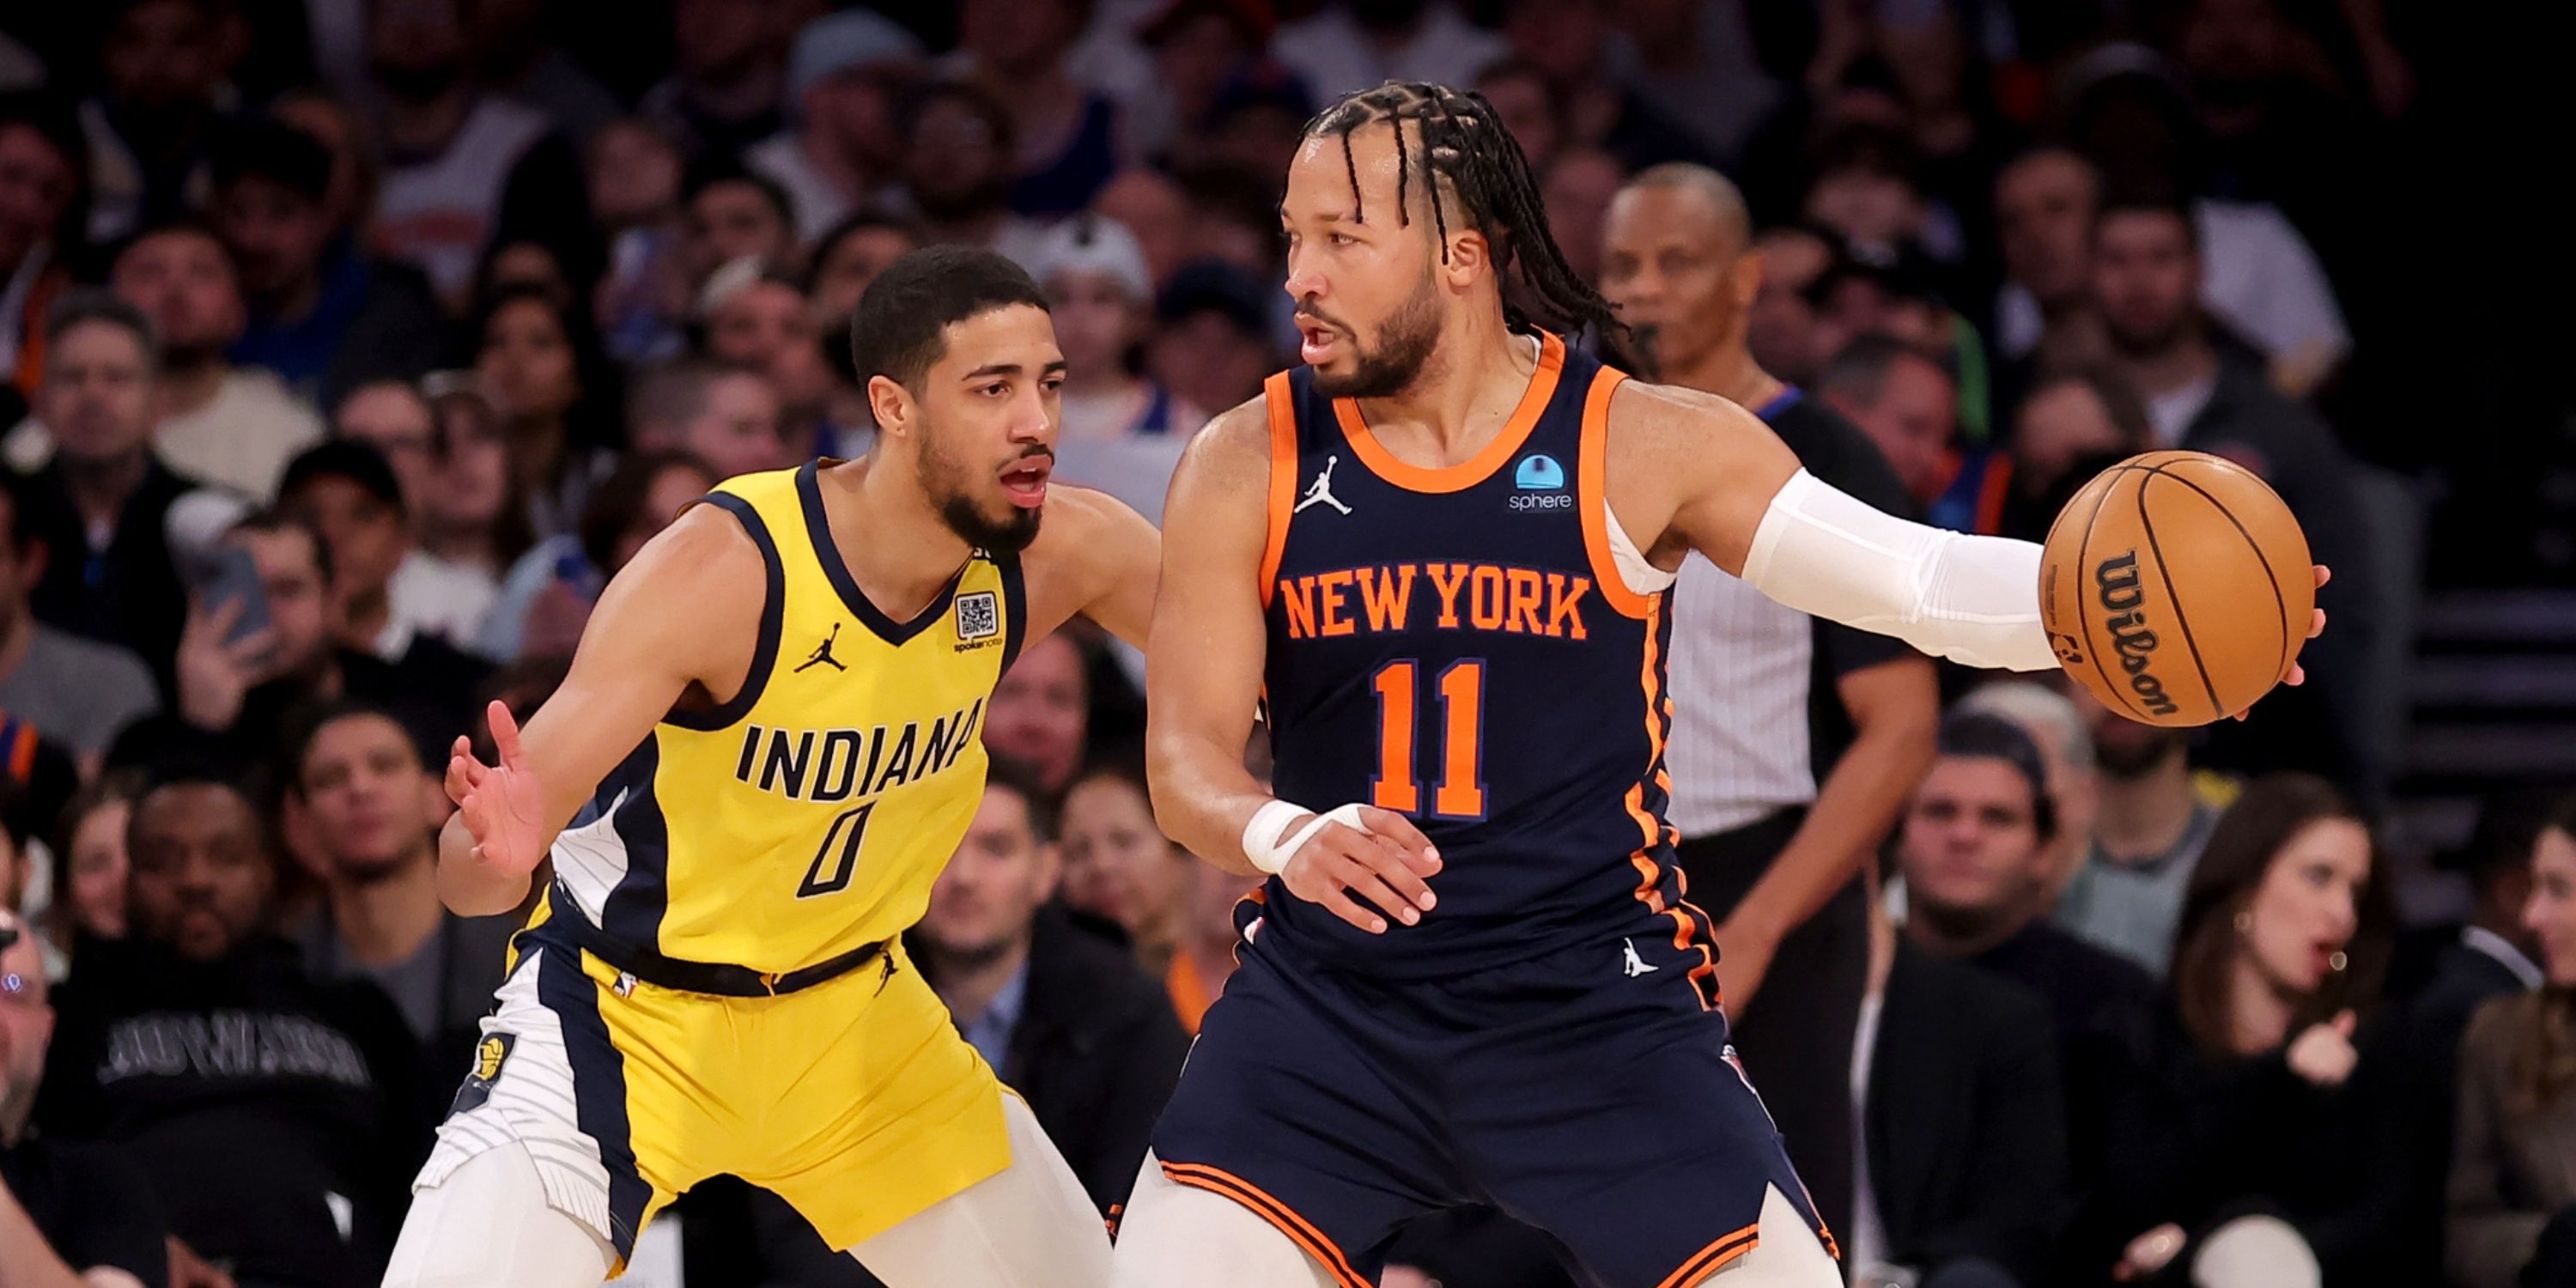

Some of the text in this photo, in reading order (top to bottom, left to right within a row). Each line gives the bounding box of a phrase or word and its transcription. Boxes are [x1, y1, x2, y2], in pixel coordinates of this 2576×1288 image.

[1509, 493, 1572, 512] sphere
[1279, 562, 1590, 641] NEW YORK
[2095, 547, 2179, 716] Wilson
[734, 696, 984, 803] INDIANA
[1369, 658, 1487, 822] 11
[795, 799, 878, 899] 0
